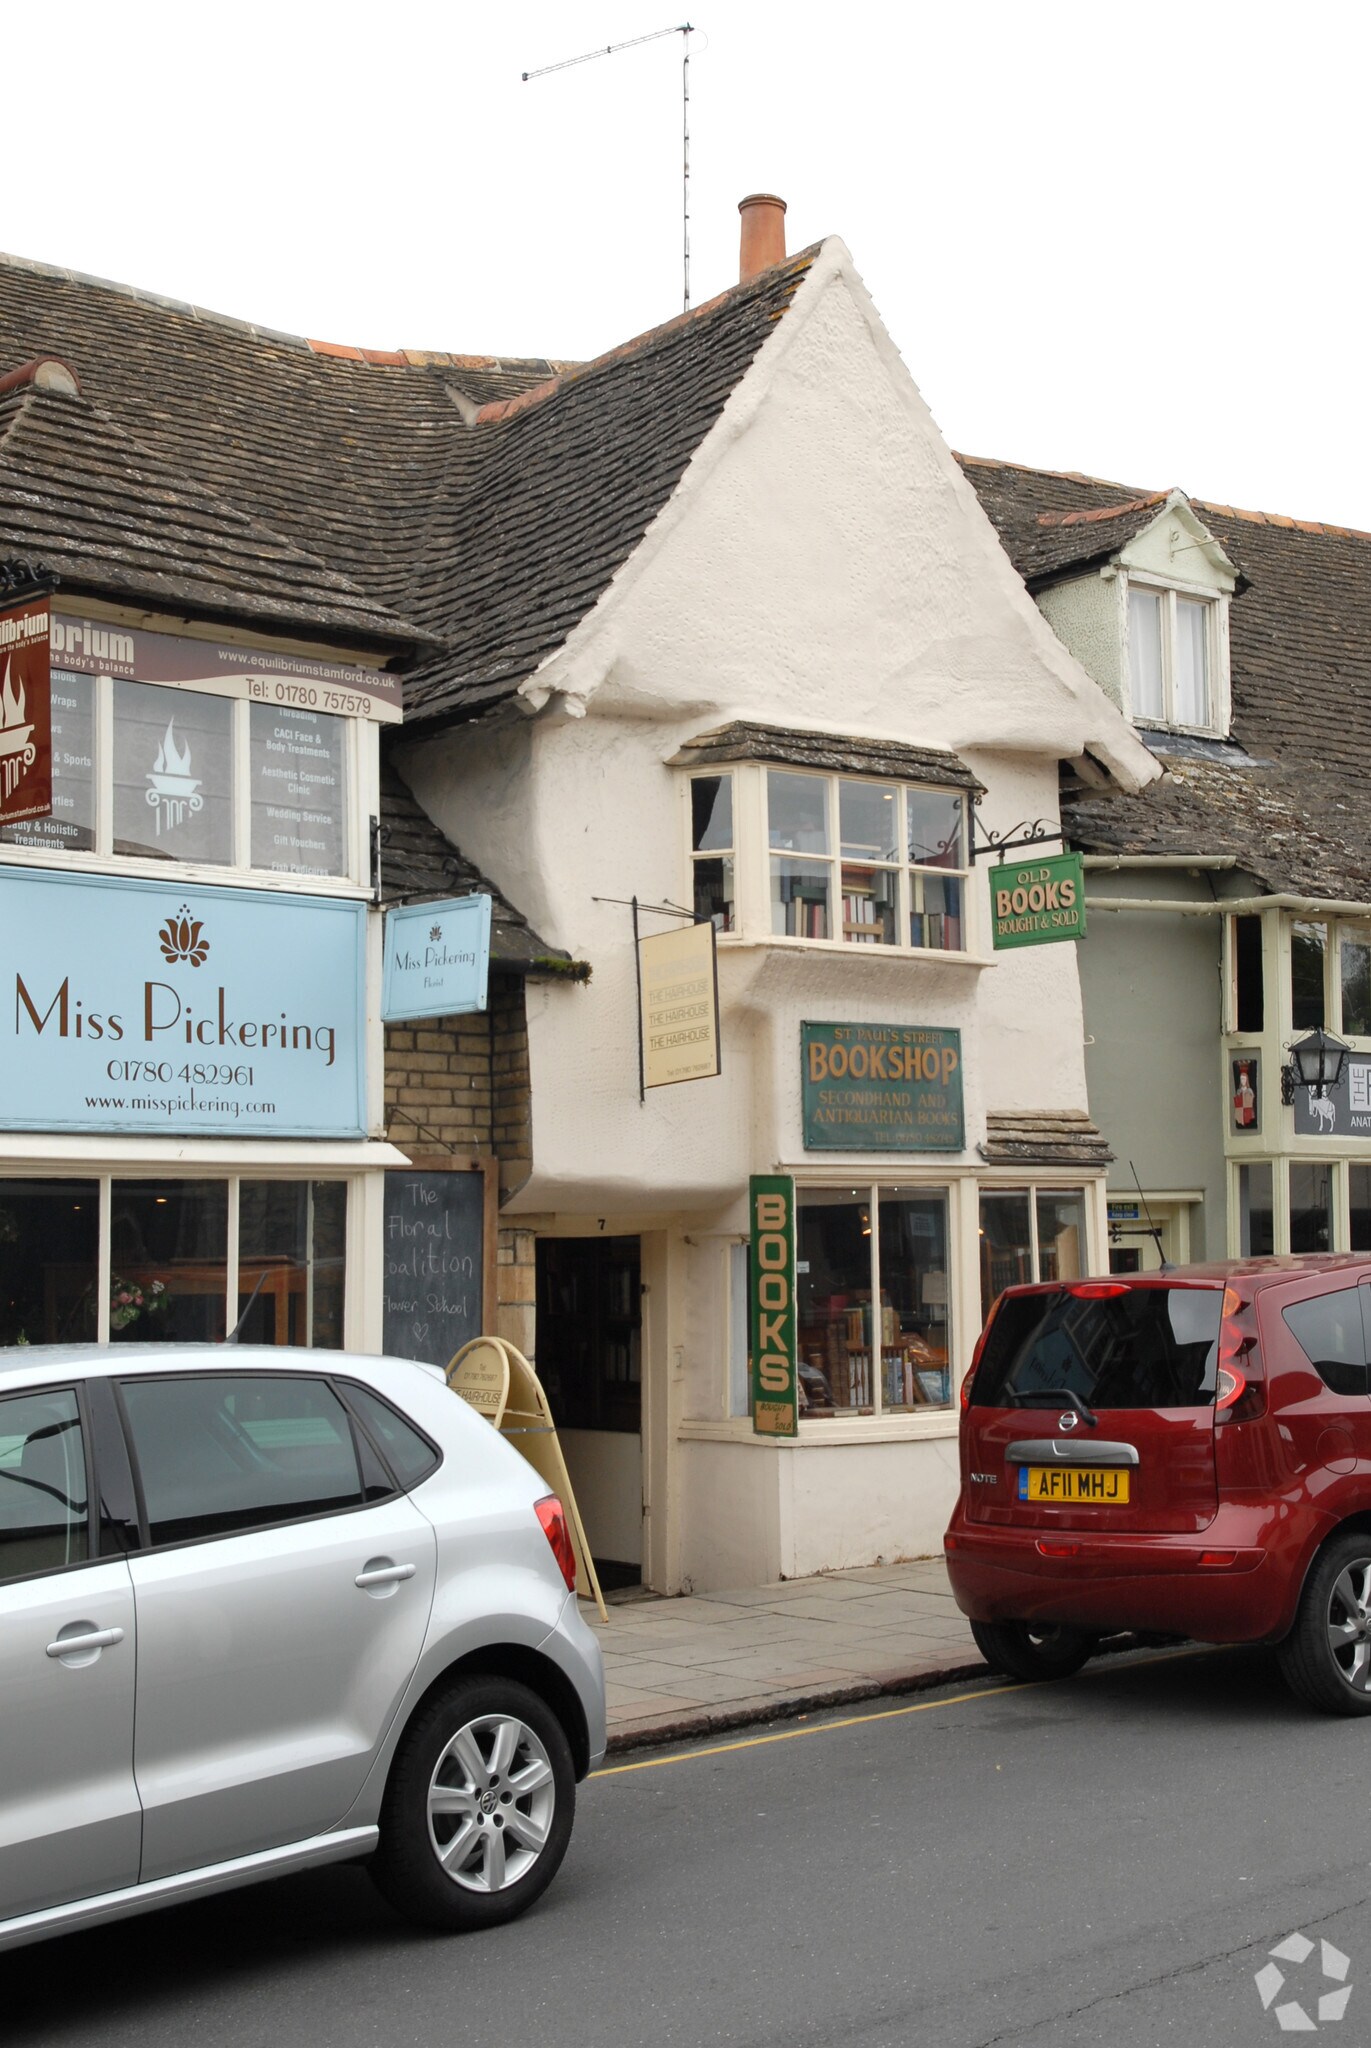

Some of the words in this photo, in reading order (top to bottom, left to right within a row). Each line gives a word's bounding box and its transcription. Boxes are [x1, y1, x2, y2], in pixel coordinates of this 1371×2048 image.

[64, 653, 94, 668] body's
[100, 660, 135, 675] balance
[218, 650, 396, 689] www.equilibriumstamford.co.uk
[246, 678, 269, 698] Tel:
[275, 683, 317, 706] 01780
[323, 691, 371, 714] 757579
[274, 727, 293, 740] CACI
[295, 732, 313, 744] Face
[315, 734, 322, 744] &
[266, 740, 286, 754] Body
[288, 743, 330, 759] Treatments
[63, 752, 91, 767] Sports
[262, 766, 298, 781] Aesthetic
[300, 771, 336, 785] Cosmetic
[288, 782, 311, 796] Clinic
[267, 807, 300, 823] Wedding
[303, 811, 332, 825] Service
[34, 821, 41, 833] &
[44, 822, 79, 837] Holistic
[14, 832, 65, 850] Treatments
[274, 834, 288, 846] Gift
[290, 837, 326, 851] Vouchers
[1017, 868, 1050, 884] OLD
[996, 879, 1076, 918] BOOKS
[998, 915, 1039, 935] BOUGHT
[1040, 914, 1049, 929] &
[1051, 910, 1079, 927] SOLD
[395, 951, 420, 971] Miss
[425, 945, 475, 967] Pickering
[16, 972, 124, 1040] Miss
[144, 981, 335, 1066] Pickering
[649, 1013, 664, 1026] THE
[650, 1037, 665, 1049] THE
[666, 1028, 710, 1046] HAIRHOUSE
[857, 1028, 899, 1042] PAUL'S
[903, 1031, 944, 1044] STREET
[107, 1059, 173, 1082] 01780
[177, 1062, 254, 1085] 482961
[808, 1042, 958, 1086] BOOKSHOP
[1353, 1068, 1365, 1105] THE
[85, 1087, 276, 1118] www.misspickering.com
[819, 1090, 911, 1107] SECONDHAND
[918, 1093, 946, 1108] AND
[813, 1108, 913, 1125] ANTIQUARIAN
[917, 1111, 958, 1126] BOOKS
[405, 1183, 439, 1206] The
[388, 1210, 452, 1239] Floral
[598, 1218, 606, 1230] 7
[757, 1194, 790, 1391] BOOKS
[426, 1293, 467, 1318] School
[760, 1402, 786, 1412] BOUGHT
[775, 1422, 792, 1431] SOLD
[971, 1472, 997, 1484] NOTE
[1039, 1472, 1072, 1497] AF11
[1078, 1473, 1118, 1498] MHJ
